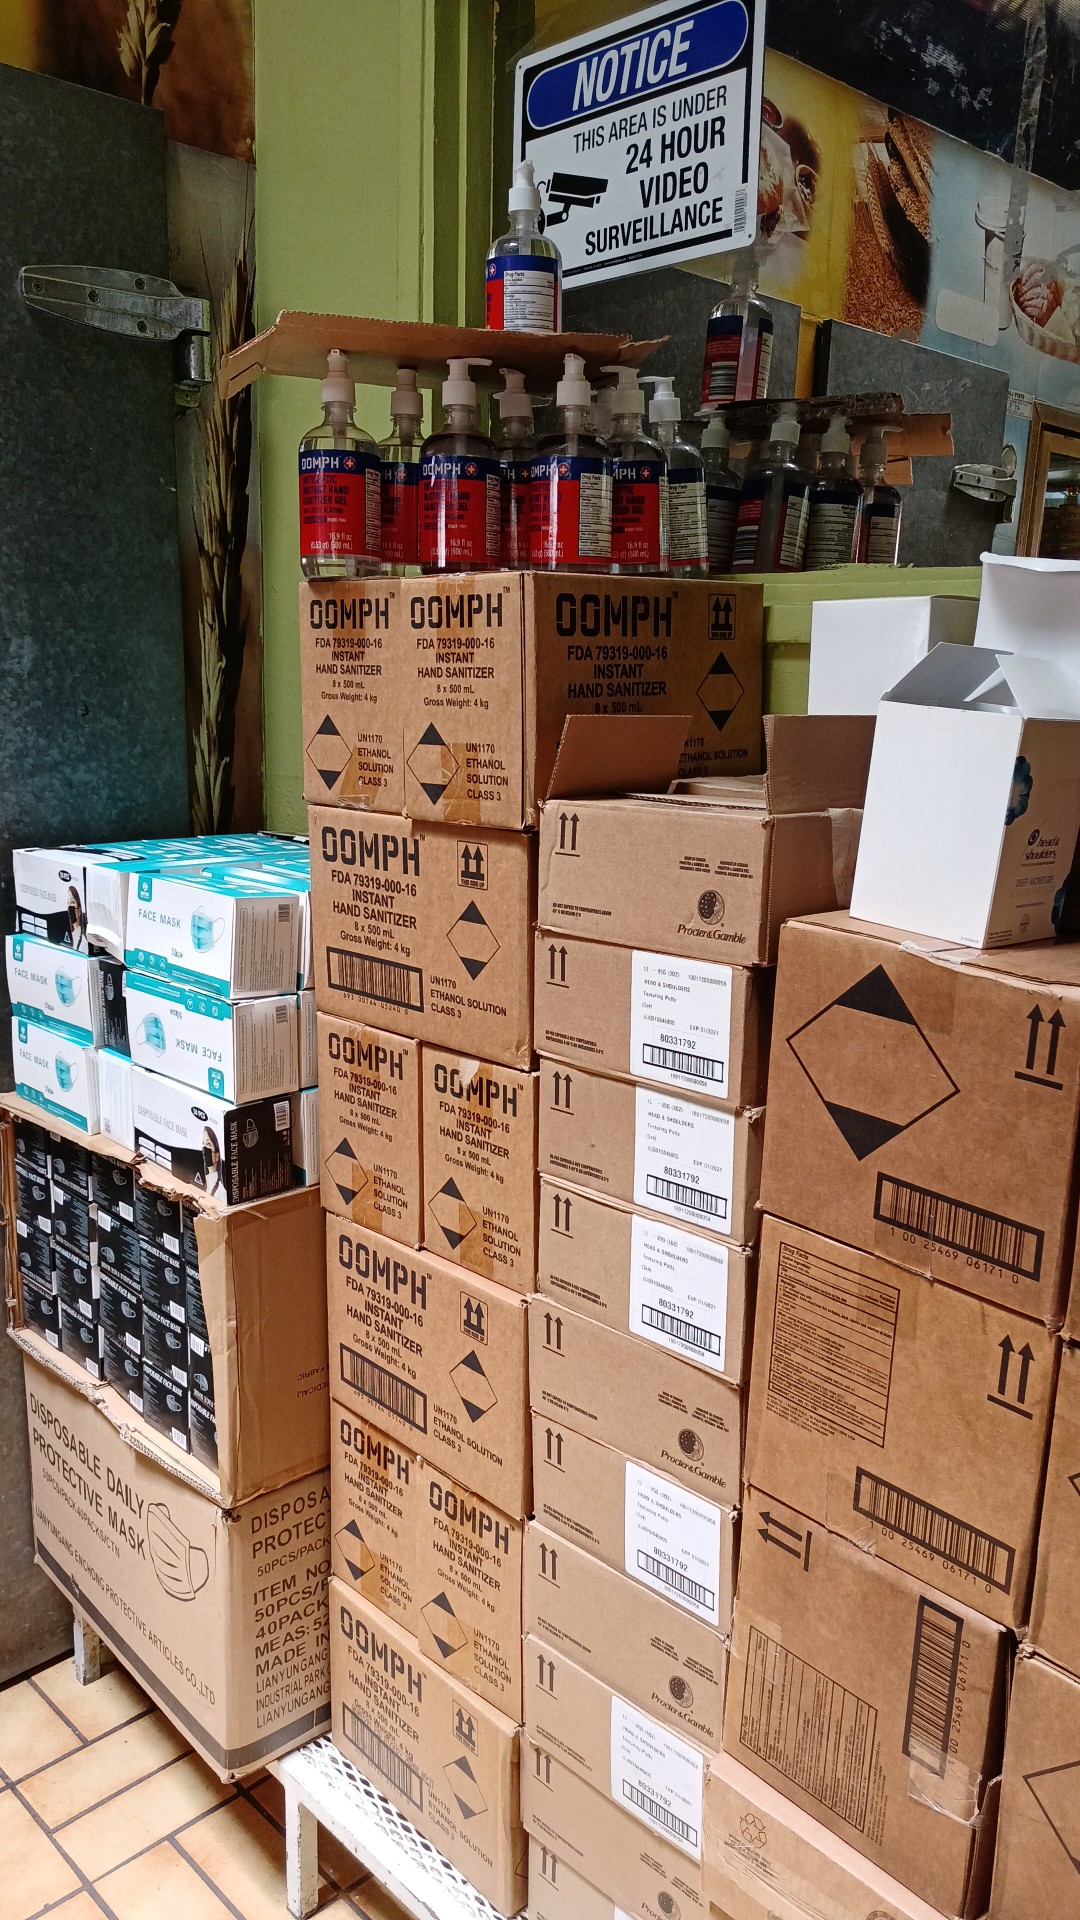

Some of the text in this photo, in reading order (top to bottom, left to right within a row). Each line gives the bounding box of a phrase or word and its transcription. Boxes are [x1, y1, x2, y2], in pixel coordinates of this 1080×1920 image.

[572, 20, 694, 112] NOTICE
[574, 85, 728, 154] THIS AREA IS UNDER
[626, 116, 726, 174] 24 HOUR
[640, 161, 709, 208] VIDEO
[585, 197, 723, 256] SURVEILLANCE
[302, 456, 339, 470] OOMPH
[423, 463, 460, 476] OOMPH
[329, 532, 340, 540] 16.9
[310, 598, 389, 630] OOMPH
[410, 592, 502, 630] OOMPH
[556, 593, 671, 637] OOMPH
[316, 637, 382, 649] FDA 79319-000-16
[331, 650, 365, 661] INSTANT
[417, 637, 495, 649] FDA 79319-000-16
[567, 645, 667, 660] FDA 79319-000-16
[316, 665, 382, 676] HAND SANITIZER
[436, 652, 474, 663] INSTANT
[593, 663, 644, 679] INSTANT
[418, 667, 494, 678] HAND SANITIZER
[437, 685, 441, 693] 8
[450, 685, 461, 694] 500
[463, 685, 474, 694] mL
[568, 681, 666, 698] HAND SANITIZER
[424, 697, 489, 710] Gross Weight: 4 kg
[358, 733, 382, 744] UN1170
[466, 743, 495, 754] UN1170
[358, 748, 391, 759] ETHANOL
[466, 758, 505, 770] ETHANOL
[358, 762, 394, 774] SOLUTION
[359, 776, 388, 787] CLASS 3
[467, 774, 508, 786] SOLUTION
[467, 789, 501, 801] CLASS 3
[322, 826, 420, 876] OOMPH
[332, 870, 417, 897] FDA 79319-000-16
[352, 889, 394, 909] INSTANT
[138, 908, 181, 929] FACE MASK
[333, 901, 417, 930] HAND SANITIZER
[15, 967, 48, 985] FACE MASK
[430, 975, 457, 989] UN1170
[431, 989, 507, 1017] ETHANOL SOLUTION
[431, 1002, 462, 1018] CLASS 3
[175, 1038, 222, 1062] FACE MASK
[660, 1034, 696, 1050] 80331792
[20, 1049, 49, 1069] FACE MASK
[329, 1032, 403, 1080] OOMPH
[334, 1067, 397, 1095] FDA 79319-000-16
[349, 1083, 381, 1101] INSTANT
[434, 1064, 517, 1118] OOMPH
[138, 1105, 163, 1125] DISPOSABLE
[334, 1090, 397, 1119] HAND SANITIZER
[439, 1101, 510, 1134] FDA 79319-000-16
[440, 1126, 509, 1160] HAND SANITIZER
[456, 1119, 492, 1140] INSTANT
[230, 1143, 238, 1163] FACE
[664, 1166, 700, 1184] 80331792
[891, 1227, 1019, 1284] 1 00 25469 06171 0
[339, 1234, 426, 1310] OOMPH
[346, 1276, 424, 1327] FDA 79319-000-16
[364, 1299, 404, 1331] INSTANT
[659, 1298, 694, 1319] 80331792
[346, 1304, 423, 1358] HAND SANITIZER
[30, 1393, 144, 1519] DISPOSABLE DAILY
[340, 1418, 409, 1485] OOMPH
[660, 1449, 727, 1489] Procter&Gamble
[33, 1427, 145, 1560] PROTECTIVE MASK
[429, 1481, 509, 1555] OOMPH
[433, 1540, 501, 1592] HAND SANITIZER
[653, 1546, 688, 1573] 80331792
[870, 1520, 992, 1594] 1 00 25469 06171 0
[36, 1506, 74, 1556] LIANYUNGANG
[74, 1550, 104, 1591] ENCHONG
[105, 1584, 147, 1637] PROTECTIVE
[148, 1630, 184, 1675] ARTICLES
[254, 1575, 296, 1605] ITEM
[255, 1626, 310, 1659] MEAS:
[340, 1605, 423, 1703] OOMPH
[256, 1642, 306, 1677] MADE
[256, 1648, 328, 1694] LIANYUNGANG
[256, 1666, 326, 1712] INDUSTRIAL PARK
[256, 1681, 330, 1729] LIANYUNGANG
[650, 1691, 714, 1738] Procter&Gamble
